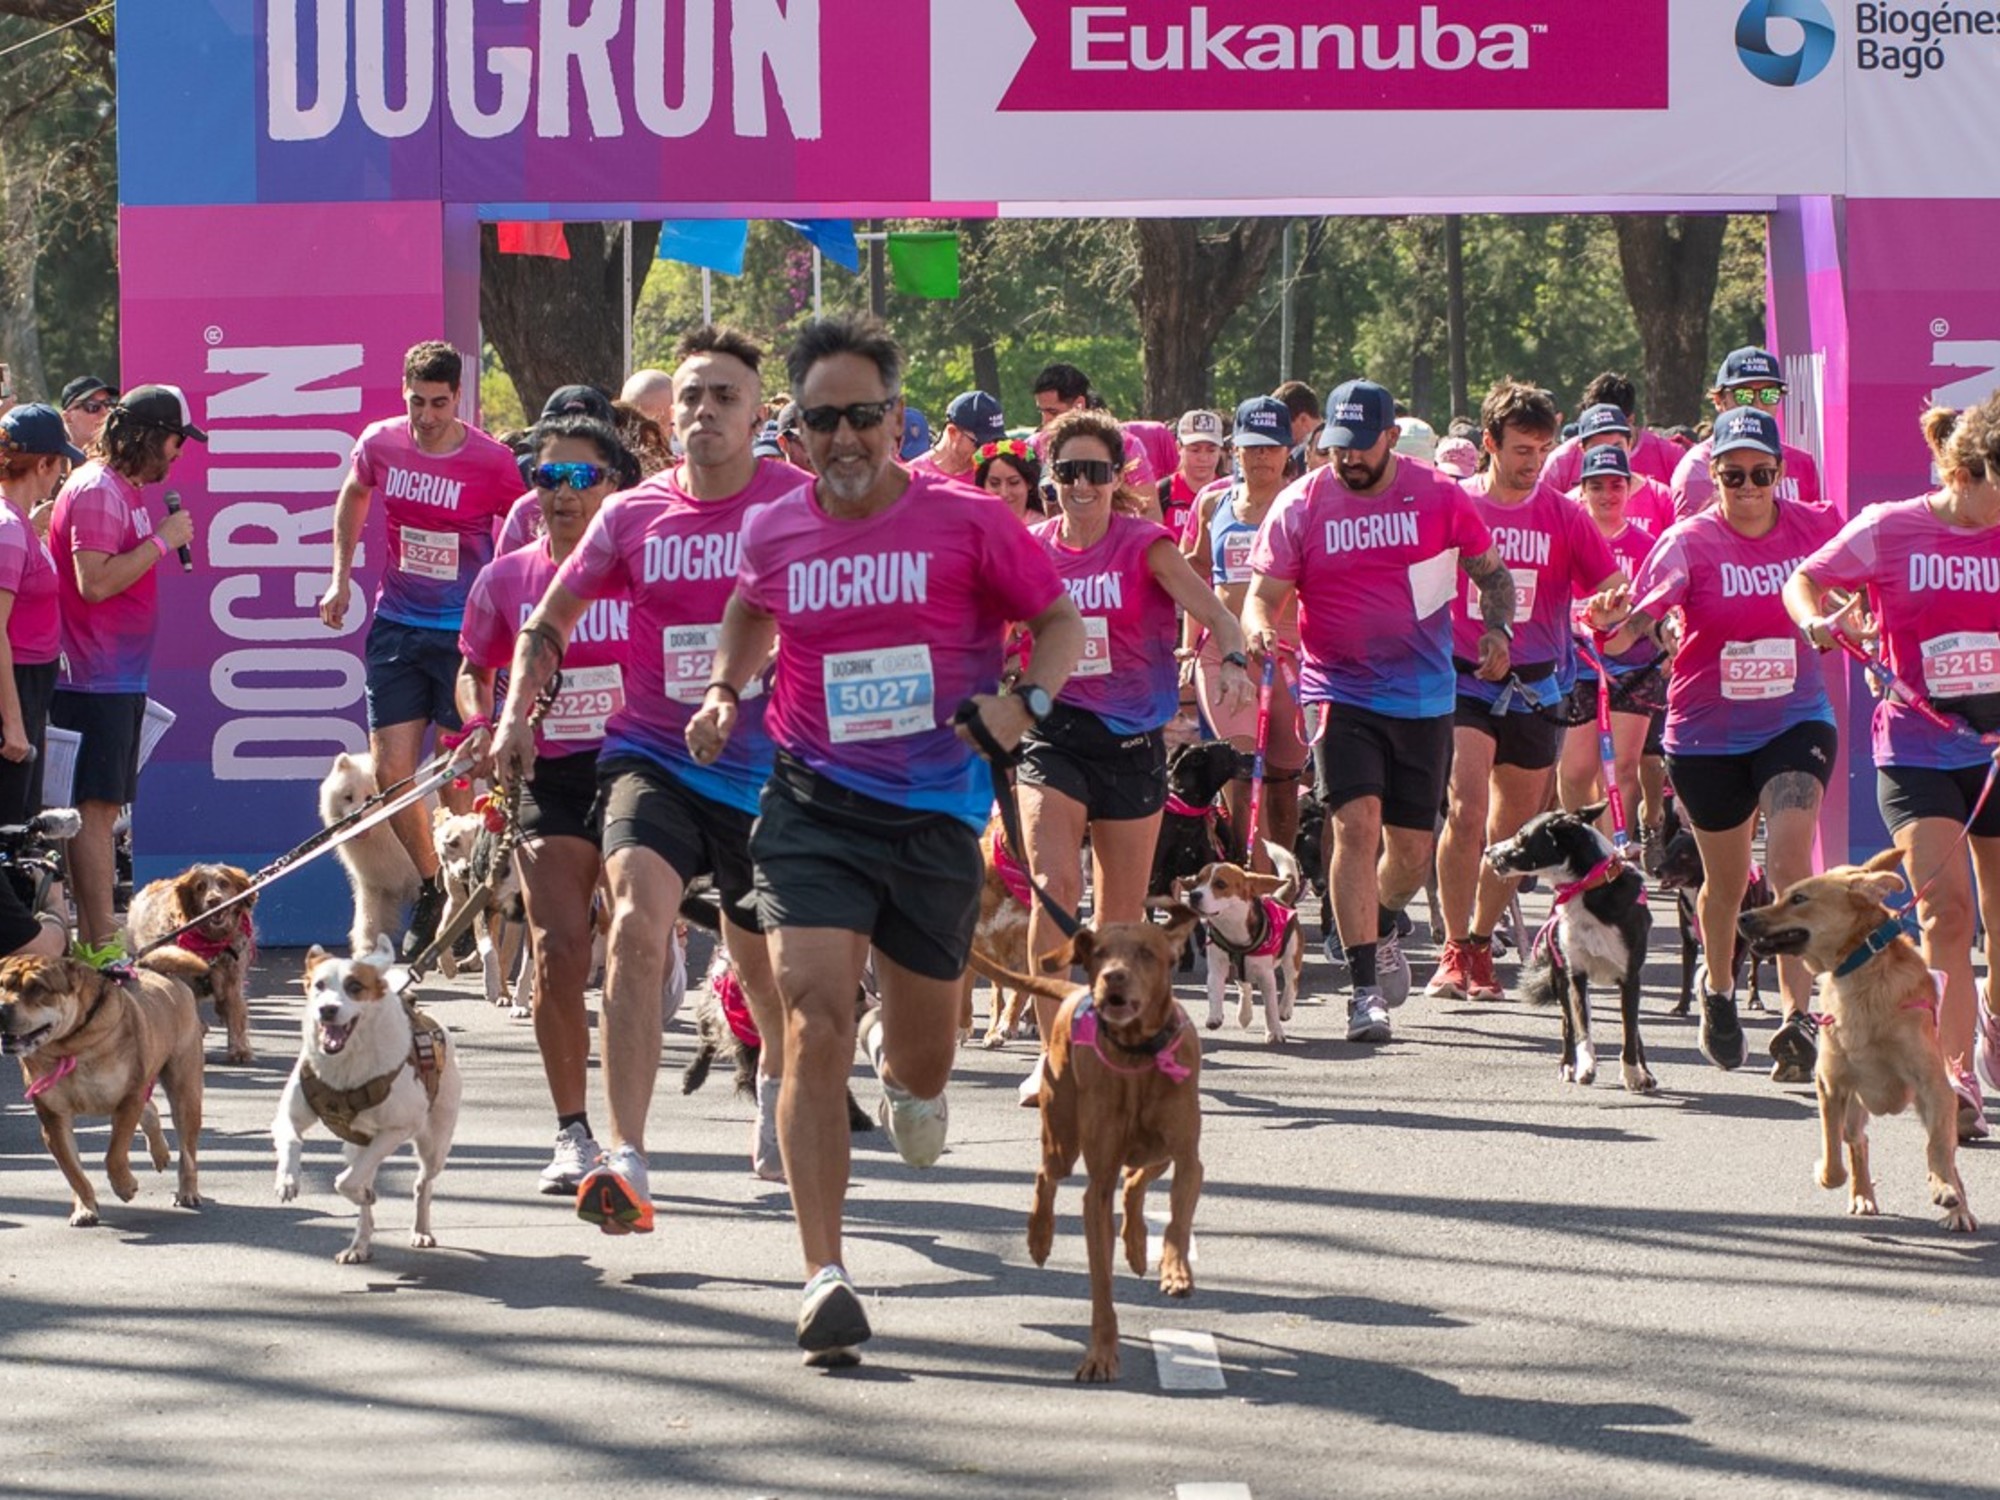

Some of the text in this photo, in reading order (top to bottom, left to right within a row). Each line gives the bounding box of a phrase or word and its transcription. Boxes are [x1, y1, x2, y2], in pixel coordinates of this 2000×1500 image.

[1858, 1, 2000, 43] Biogéne
[1858, 38, 1945, 79] Bagó
[386, 466, 462, 510] DOGRUN
[1325, 511, 1419, 555] DOGRUN
[1488, 526, 1551, 566] GRUN
[407, 545, 451, 564] 5274
[644, 531, 742, 583] DOGRU
[1909, 553, 2000, 594] DOGRU
[787, 551, 928, 614] DOGRUN
[677, 654, 714, 678] 52
[1730, 660, 1786, 680] 5223
[1934, 652, 1994, 677] 5215
[551, 691, 613, 716] 5229
[841, 678, 920, 711] 5027
